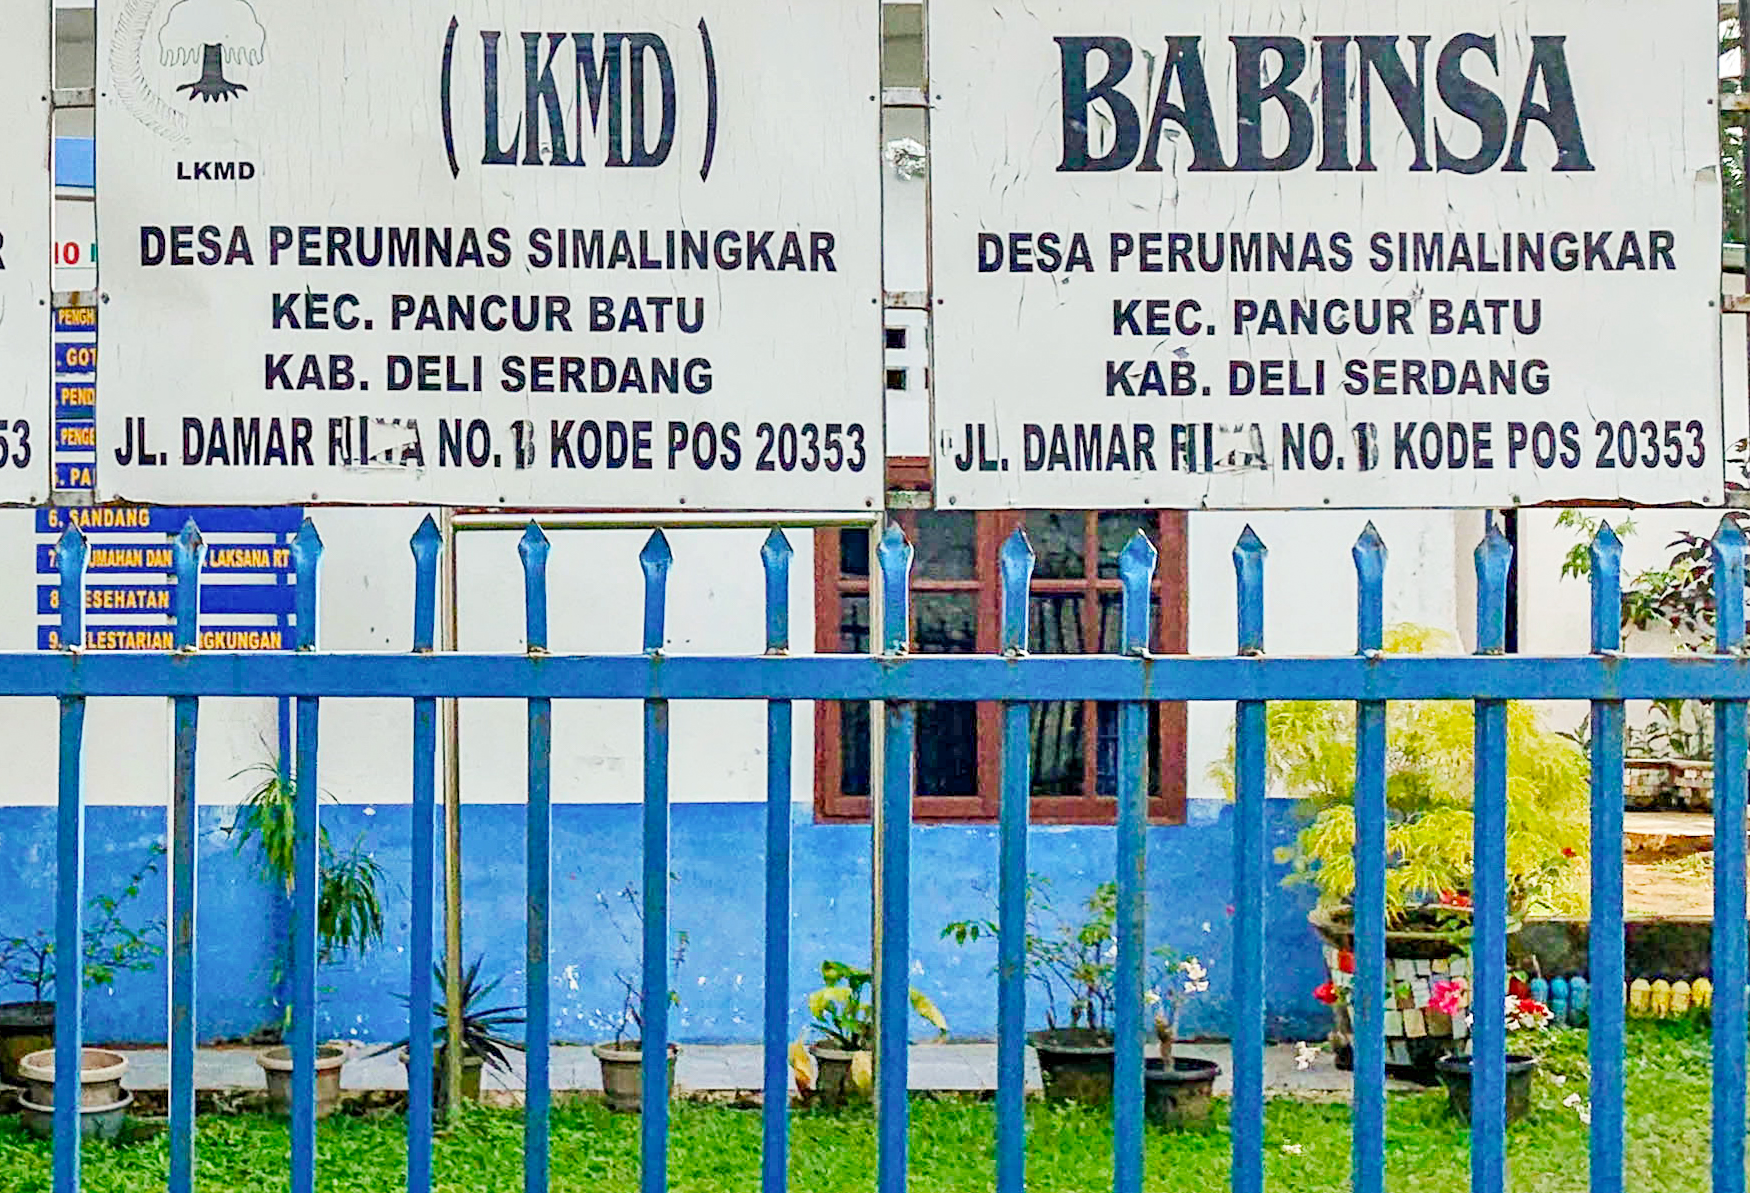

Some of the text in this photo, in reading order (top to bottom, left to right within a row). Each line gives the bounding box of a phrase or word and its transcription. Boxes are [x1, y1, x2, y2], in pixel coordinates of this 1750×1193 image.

[1054, 33, 1595, 174] BABINSA
[178, 162, 254, 180] LKMD
[141, 226, 253, 266] DESA
[270, 226, 511, 267] PERUMNAS
[528, 228, 836, 271] SIMALINGKAR
[979, 231, 1676, 273] DESA PERUMNAS SIMALINGKAR
[273, 293, 703, 333] KEC. PANCUR BATU
[1114, 299, 1540, 335] KEC. PANCUR BATU
[266, 354, 712, 394] KAB. DELI SERDANG
[1107, 360, 1549, 396] KAB. DELI SERDANG
[115, 417, 166, 466] JL.
[183, 417, 314, 465] DAMAR
[440, 419, 500, 467] NO.
[551, 420, 652, 469] KODE
[669, 422, 741, 470] POS
[756, 423, 865, 472] 20353
[955, 424, 1008, 471] JL.
[1024, 424, 1156, 471] DAMAR
[1282, 423, 1344, 471] NO.
[1395, 422, 1493, 469] KODE
[1508, 422, 1580, 468] POS
[1596, 420, 1705, 468] 20353
[69, 508, 150, 528] SANDANG
[146, 550, 173, 567] DAN
[210, 549, 270, 568] LAKSANA
[273, 549, 291, 567] RT
[86, 590, 169, 609] ESEHATAN
